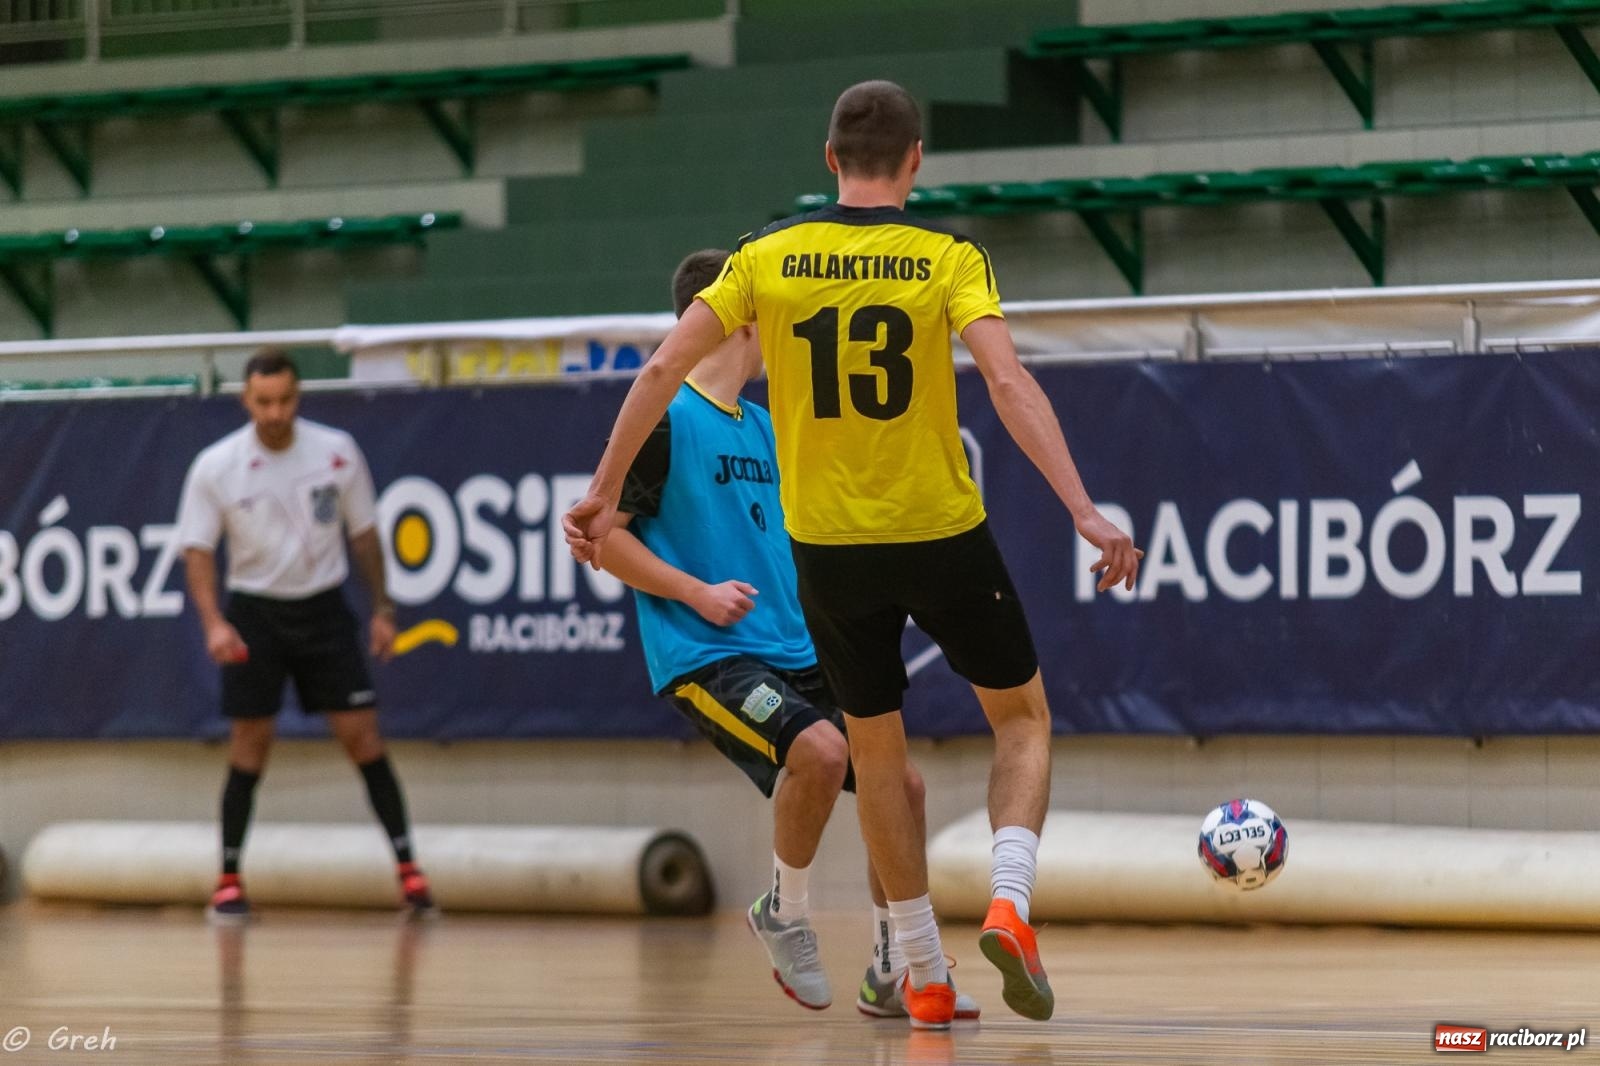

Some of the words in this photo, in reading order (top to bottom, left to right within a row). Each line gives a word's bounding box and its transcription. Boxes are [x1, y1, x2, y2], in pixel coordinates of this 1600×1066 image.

[782, 253, 932, 281] GALAKTIKOS
[793, 305, 914, 420] 13
[715, 454, 774, 485] Joma
[1075, 459, 1582, 601] RACIBÓRZ
[469, 603, 624, 650] RACIBÓRZ
[1219, 825, 1266, 846] SELECT
